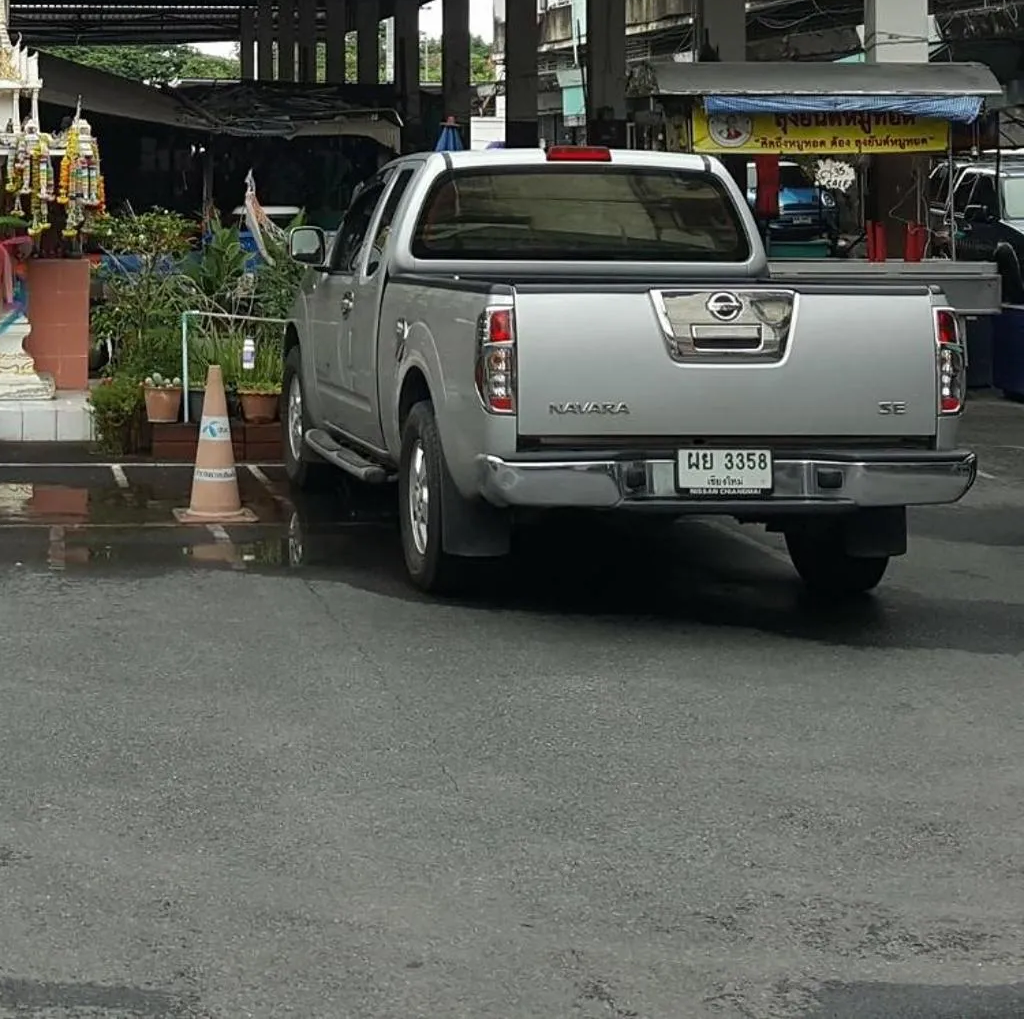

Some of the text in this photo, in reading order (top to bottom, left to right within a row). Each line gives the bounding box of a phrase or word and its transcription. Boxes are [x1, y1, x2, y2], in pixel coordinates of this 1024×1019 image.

[549, 401, 630, 415] NAVARA
[878, 401, 906, 415] SE
[687, 452, 768, 470] ผย 3358
